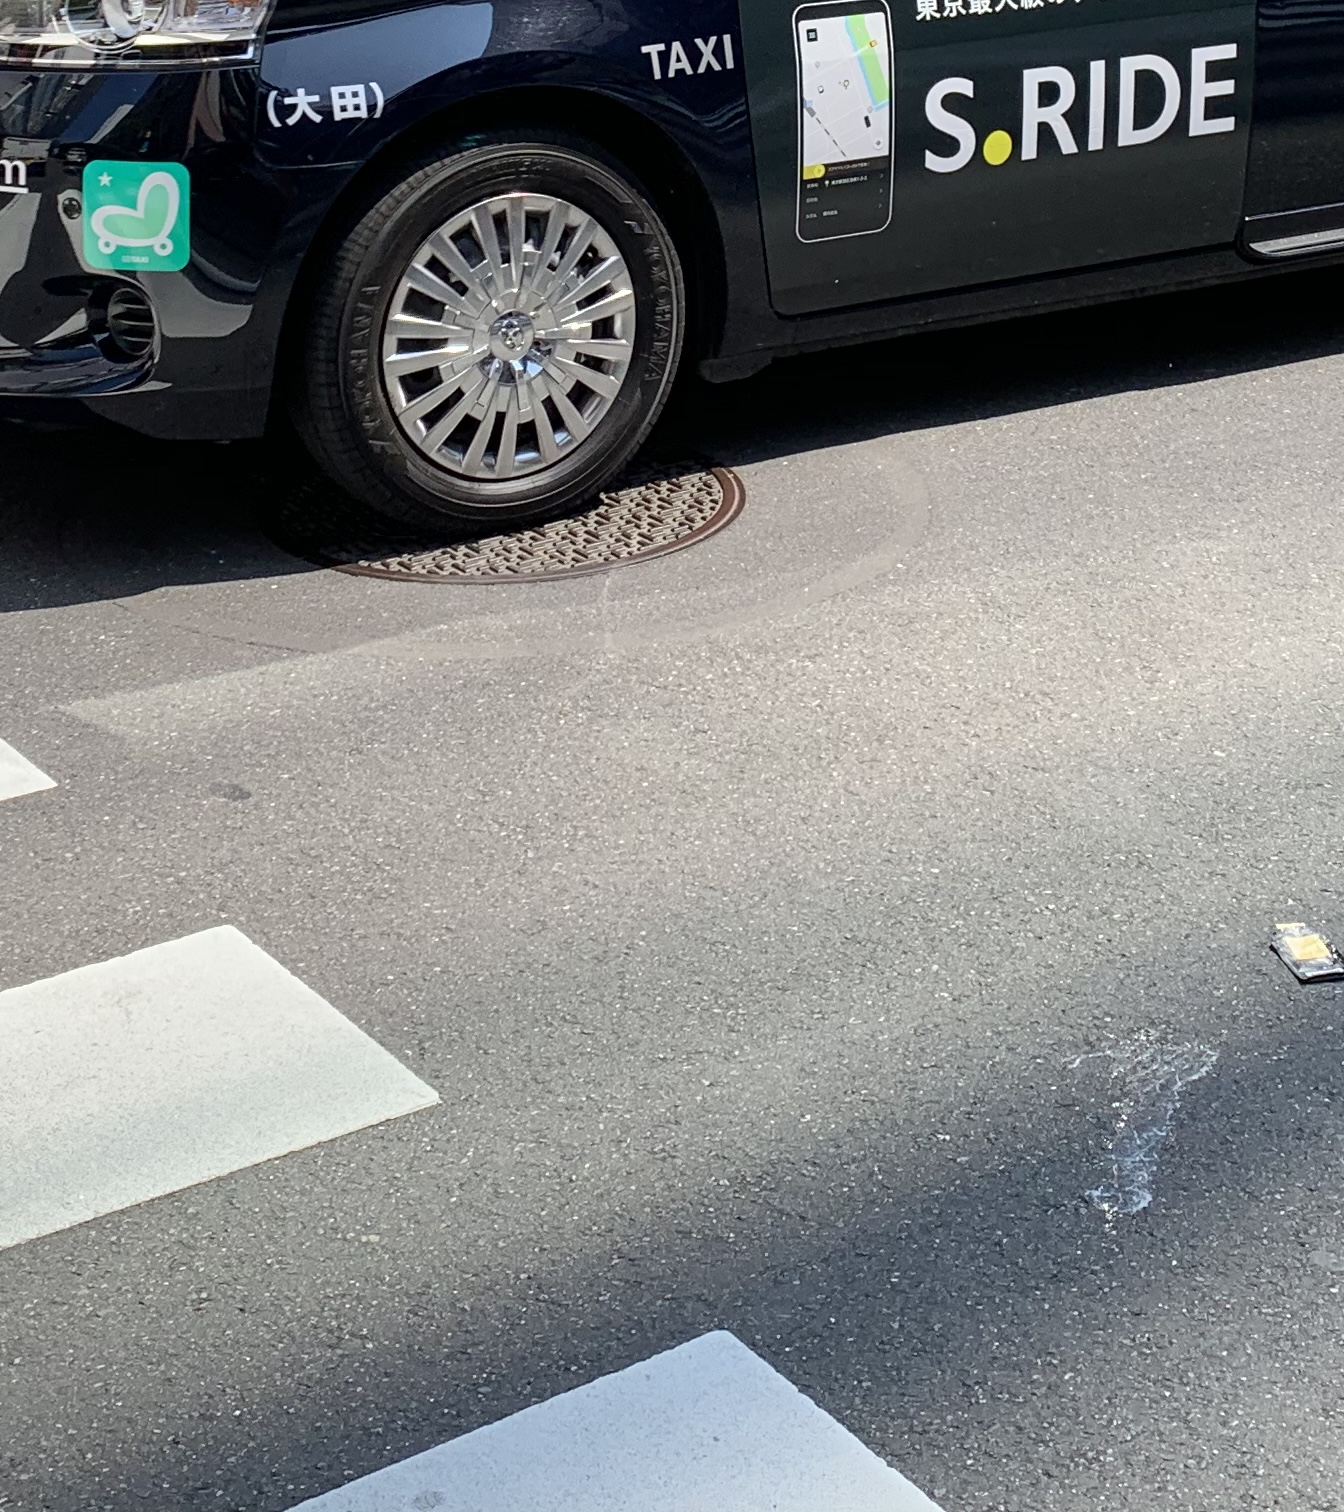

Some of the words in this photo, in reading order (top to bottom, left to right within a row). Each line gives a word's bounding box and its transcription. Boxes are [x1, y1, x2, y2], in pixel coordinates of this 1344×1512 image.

[640, 33, 735, 80] TAXI
[266, 81, 384, 128] (大田)
[924, 43, 1238, 173] S.RIDE
